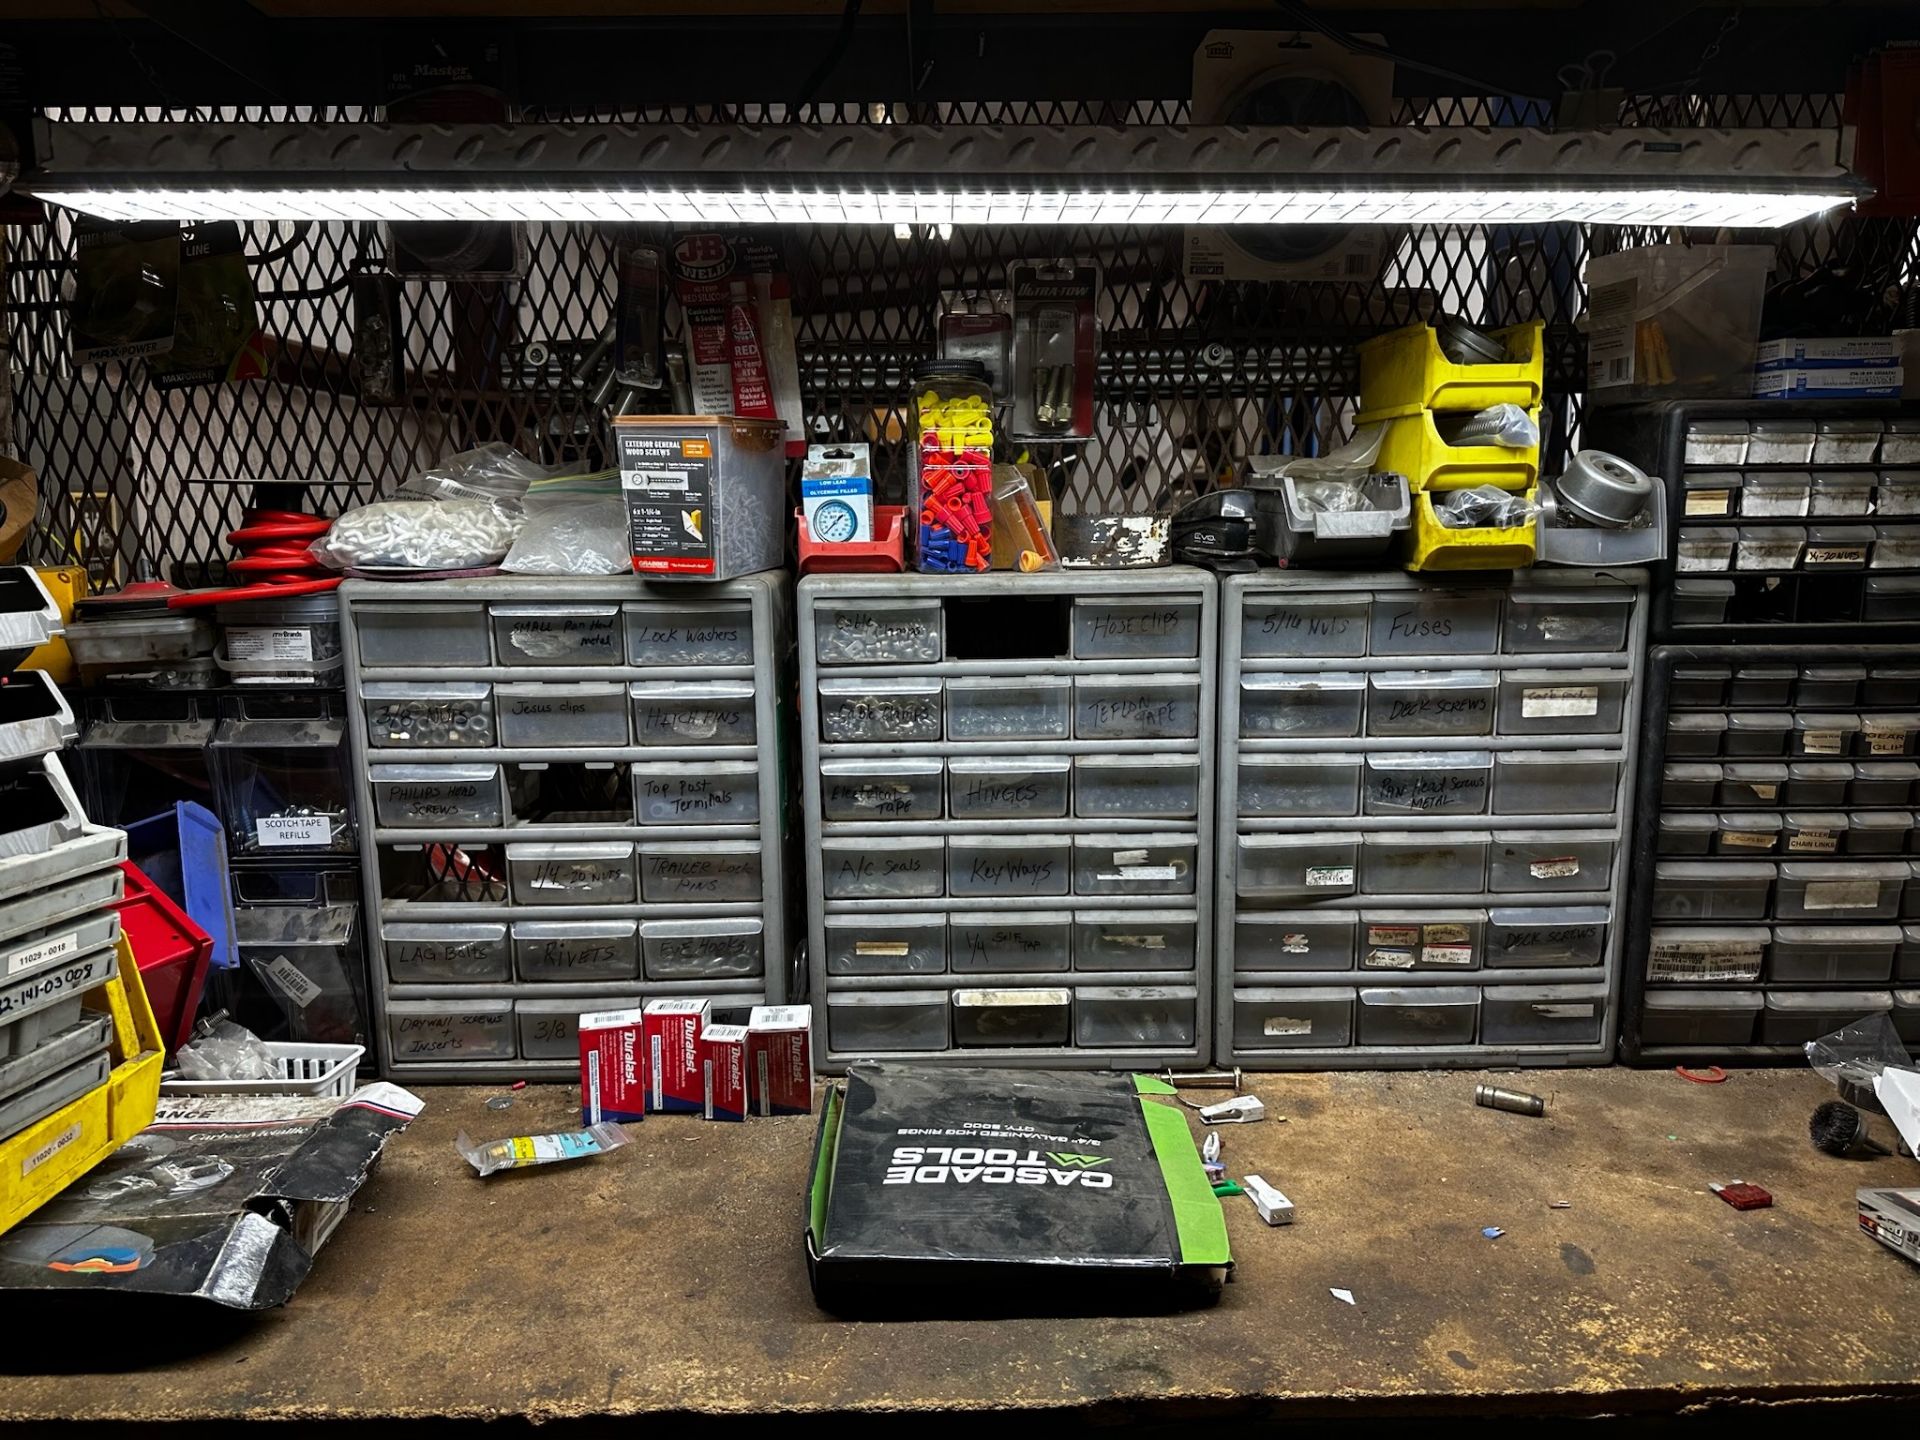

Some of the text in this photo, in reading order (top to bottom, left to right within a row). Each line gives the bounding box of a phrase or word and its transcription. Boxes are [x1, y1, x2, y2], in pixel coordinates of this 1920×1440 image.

[186, 241, 210, 257] LINE
[734, 344, 759, 356] RED
[625, 440, 654, 449] EXTERIOR
[654, 440, 681, 449] GENERAL
[625, 448, 670, 457] WOOD SCREWS
[1388, 611, 1453, 640] Fuses
[511, 701, 551, 715] Jesus
[702, 711, 741, 726] PINS
[1867, 732, 1905, 741] GEAR
[967, 779, 1039, 805] HINGES
[1412, 775, 1446, 795] Head
[1410, 795, 1454, 811] METAL
[265, 819, 321, 828] SCOTCH TAPE
[279, 831, 311, 839] REFILLS
[838, 856, 875, 882] A/C
[48, 943, 66, 955] 0018
[400, 947, 436, 963] LAG
[685, 1017, 698, 1074] Duralast
[623, 1029, 637, 1086] Duralast
[791, 1033, 805, 1084] Duralast
[729, 1046, 742, 1091] Duralast
[155, 1109, 215, 1119] ANCE
[897, 1128, 943, 1136] RINGS
[944, 1129, 977, 1137] HOG
[963, 1122, 1002, 1130] 5000
[979, 1129, 1069, 1144] GALVANIZED
[891, 1147, 1047, 1166] TOOLS
[882, 1165, 1114, 1189] CASCADE
[1906, 1230, 1920, 1250] SP
